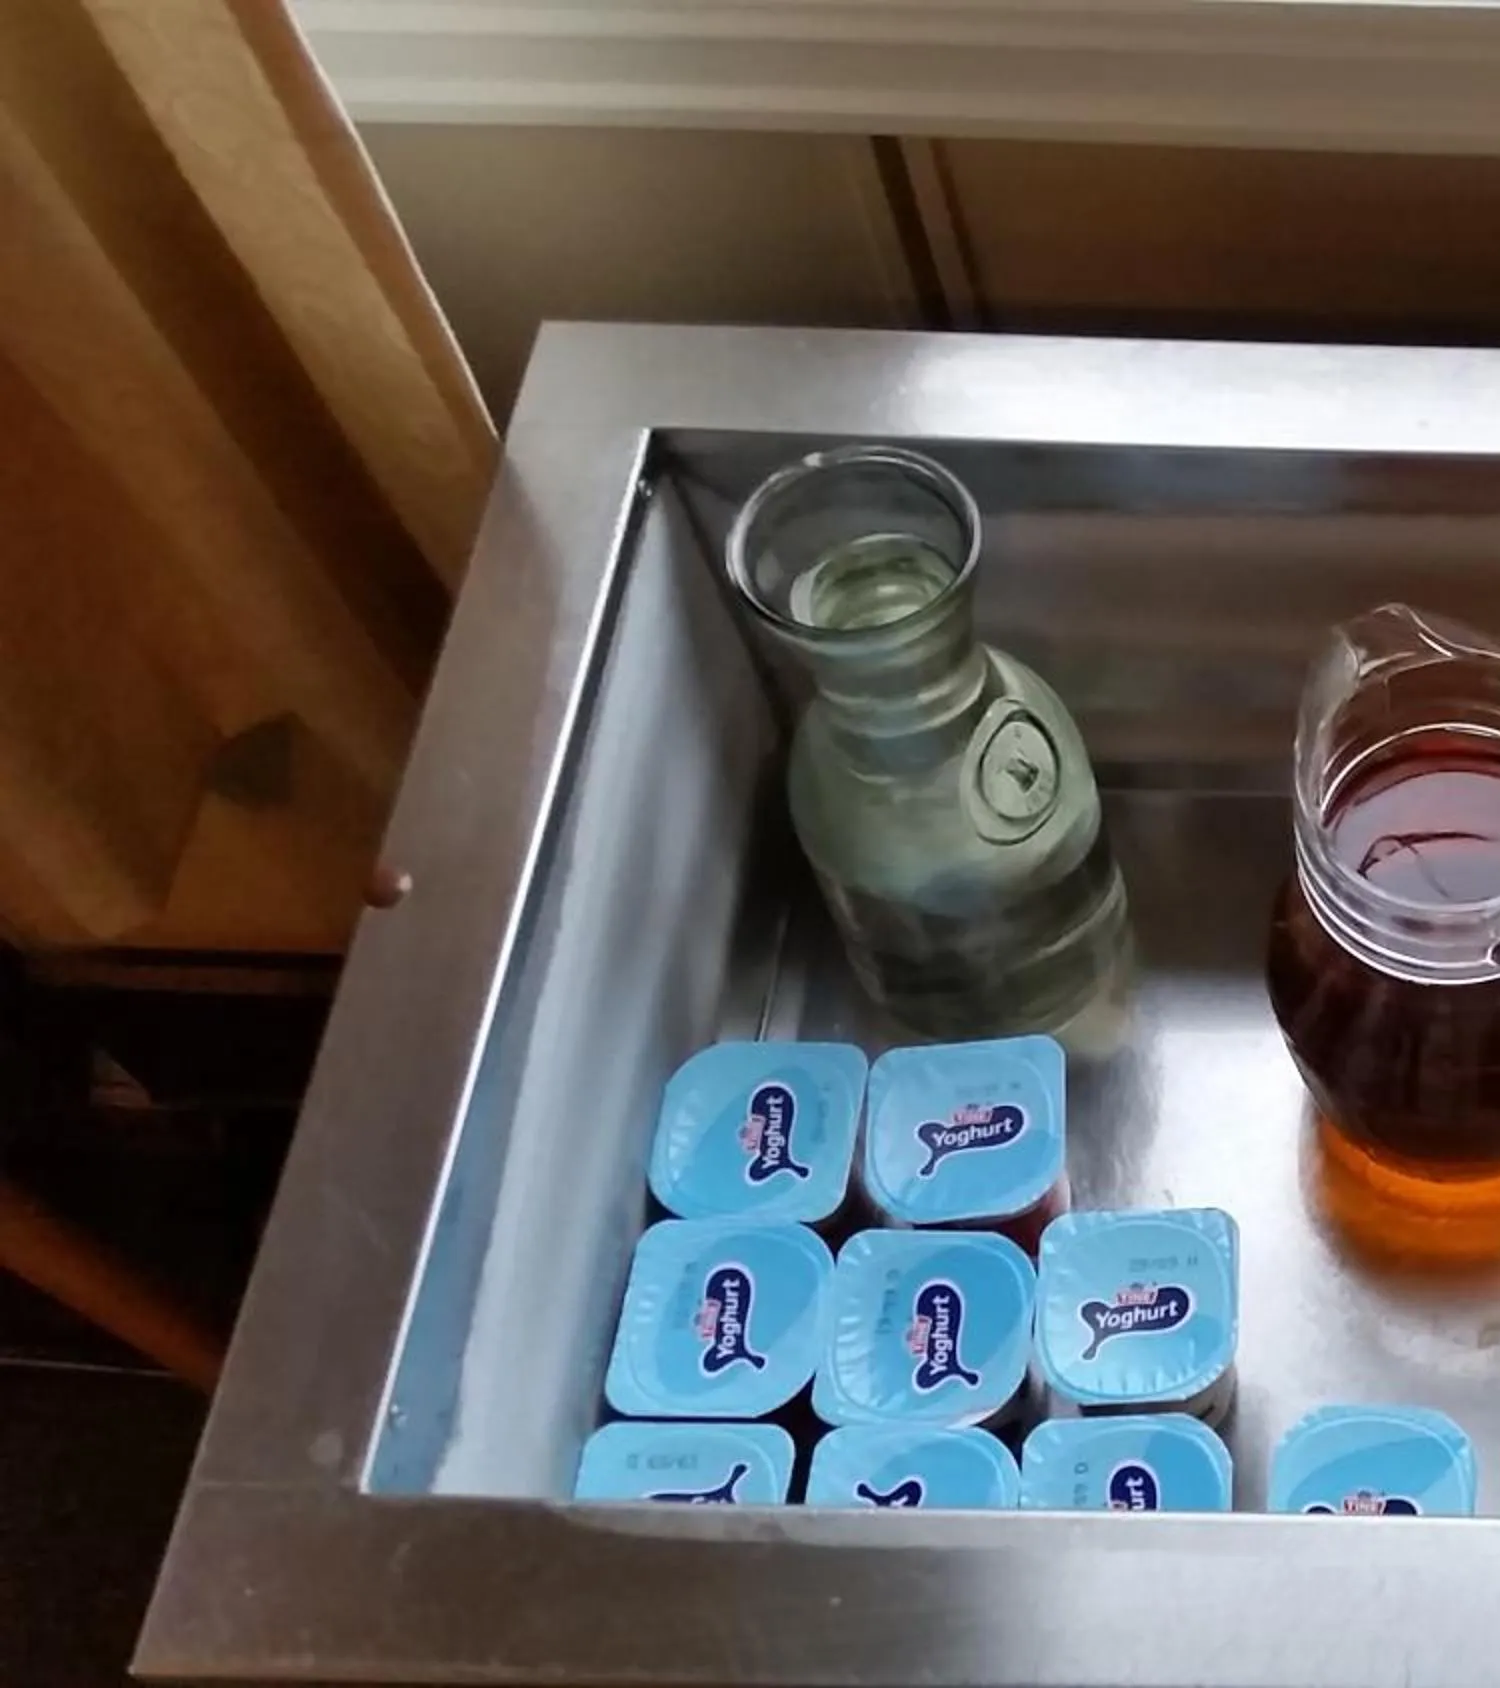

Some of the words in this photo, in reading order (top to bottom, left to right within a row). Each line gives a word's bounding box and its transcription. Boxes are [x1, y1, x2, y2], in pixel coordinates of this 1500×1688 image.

[761, 1095, 785, 1169] Yoghurt
[931, 1117, 1013, 1147] Yoghurt
[715, 1279, 741, 1359] Yoghurt
[929, 1295, 953, 1376] Yoghurt
[1096, 1300, 1178, 1329] Yoghurt
